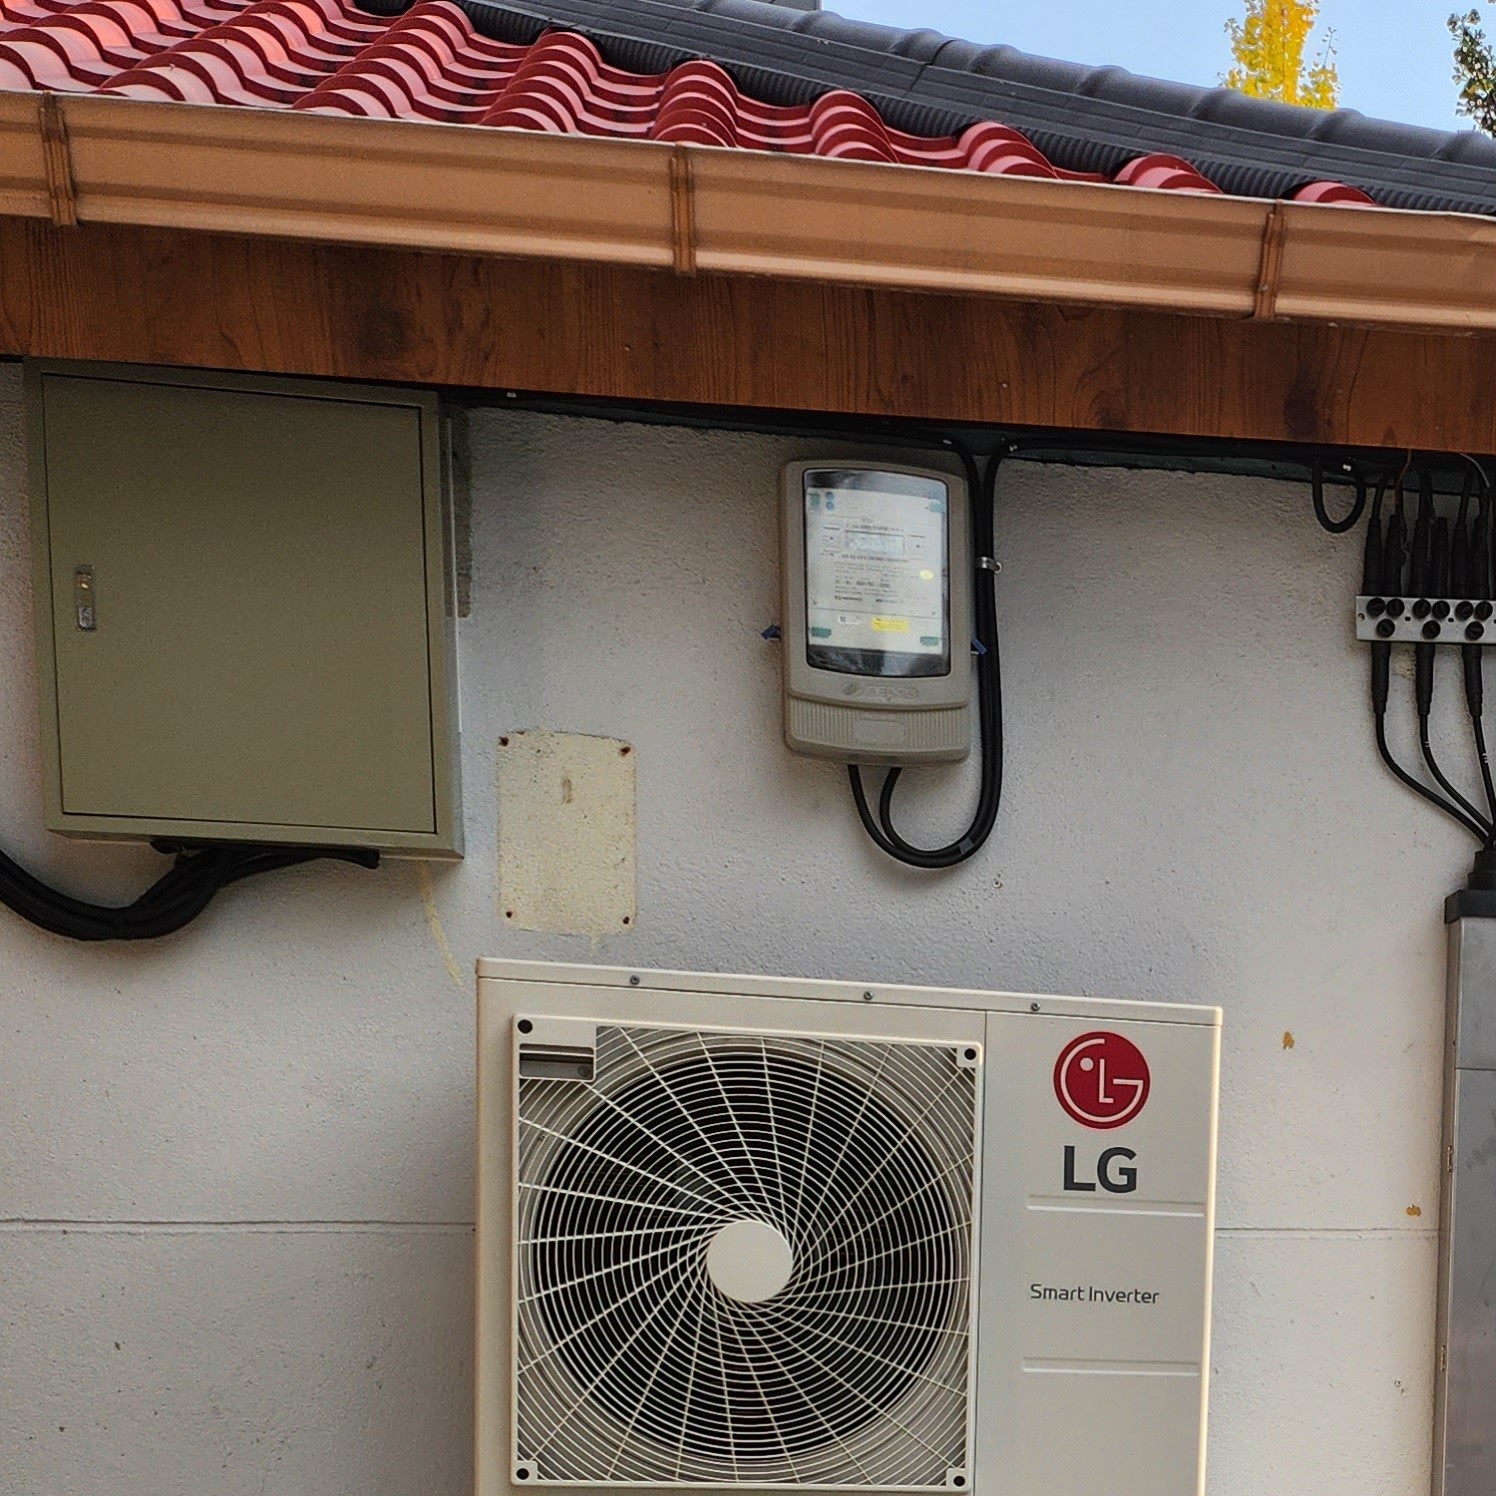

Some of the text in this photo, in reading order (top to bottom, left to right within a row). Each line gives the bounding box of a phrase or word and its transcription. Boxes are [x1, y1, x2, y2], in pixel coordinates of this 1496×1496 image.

[1063, 1145, 1138, 1193] LG
[1030, 1283, 1160, 1305] Smart Inverter
